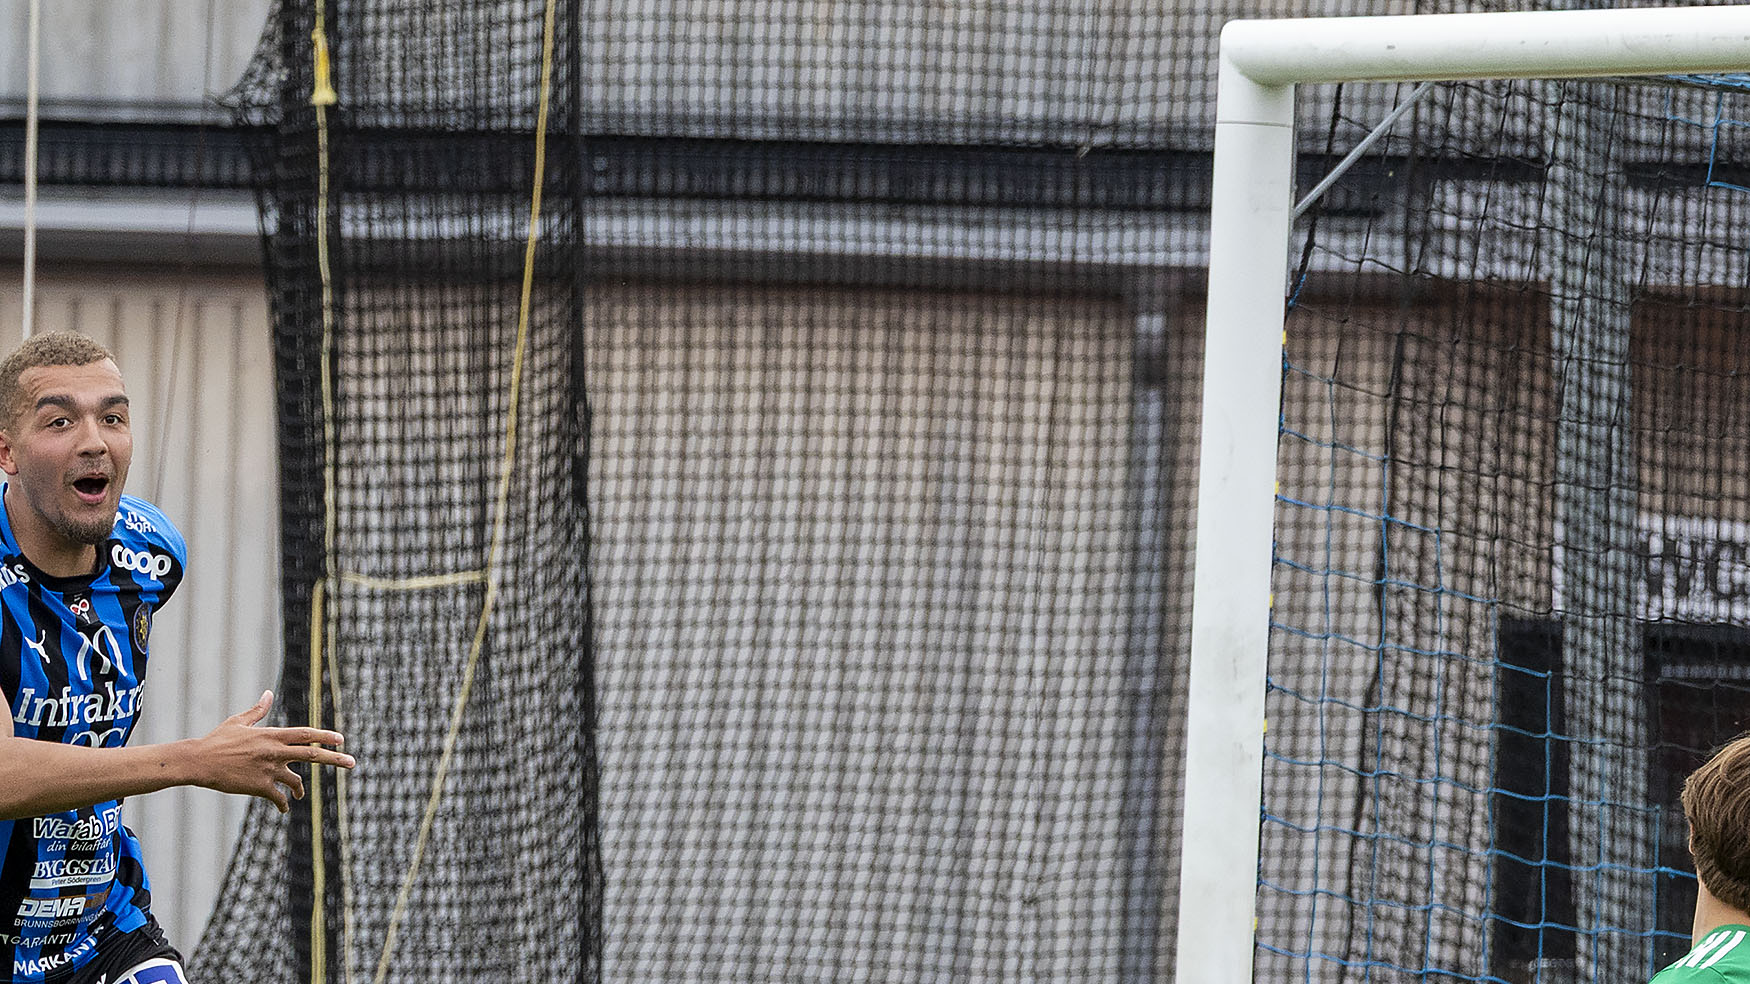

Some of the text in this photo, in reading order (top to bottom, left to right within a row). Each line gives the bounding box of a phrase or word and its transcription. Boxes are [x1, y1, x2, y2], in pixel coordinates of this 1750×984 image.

[111, 544, 172, 581] coop
[33, 815, 103, 840] Wafab
[31, 851, 117, 878] BYGGSTÅL
